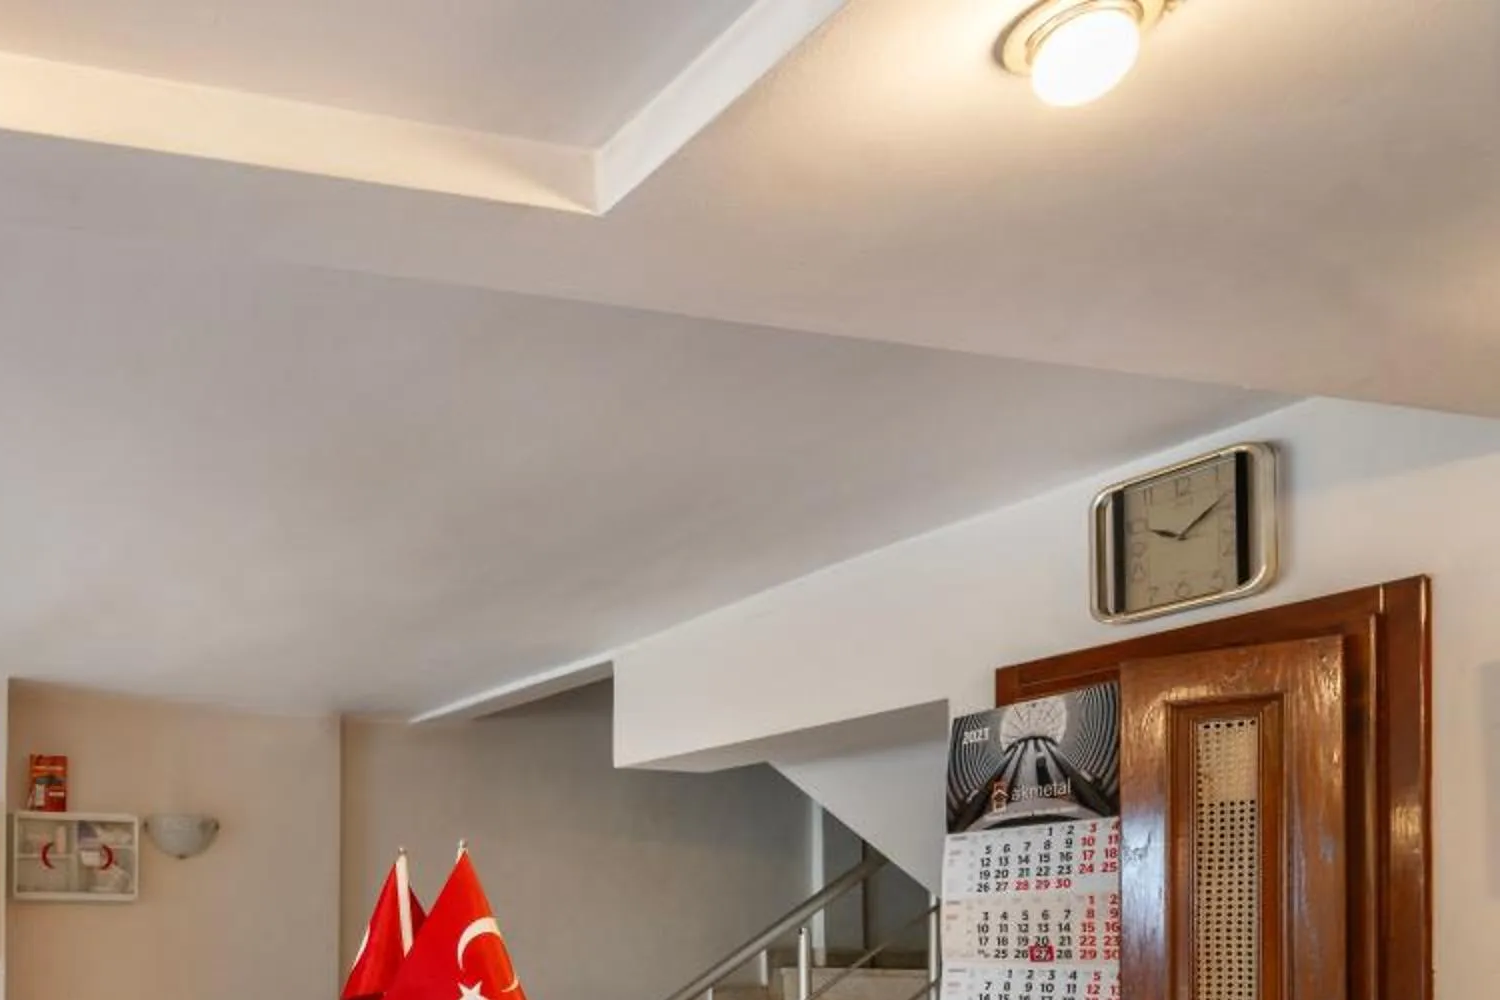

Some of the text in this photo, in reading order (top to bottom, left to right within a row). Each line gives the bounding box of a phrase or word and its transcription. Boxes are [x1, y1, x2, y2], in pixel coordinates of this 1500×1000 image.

[1011, 777, 1071, 801] akmetal
[1048, 828, 1053, 836] 1
[1068, 825, 1074, 834] 2
[1090, 823, 1096, 833] 3
[986, 836, 1119, 854] 5 6 7 8 9 10 11
[980, 849, 1117, 867] 12 13 14 15 16 17 18
[980, 862, 1117, 880] 19 20 21 22 23 24 25
[977, 879, 1071, 892] 26 27 28 29 30
[1089, 894, 1117, 904] 1 2
[983, 909, 1119, 920] 3 4 5 6 7 8 9
[977, 924, 989, 933] 10
[1000, 924, 1008, 932] 11
[1017, 924, 1028, 932] 12
[1037, 923, 1049, 932] 13
[1058, 923, 1071, 932] 14
[1081, 923, 1095, 932] 15
[979, 937, 988, 945] 17
[998, 936, 1008, 945] 18
[1017, 936, 1028, 945] 19
[1035, 936, 1049, 946] 20
[1059, 936, 1071, 945] 21
[1080, 936, 1096, 946] 22
[994, 950, 1008, 958] 25
[1015, 950, 1028, 958] 26
[1036, 950, 1050, 960] 27
[1057, 950, 1072, 959] 28
[1080, 950, 1096, 960] 29
[1008, 970, 1101, 981] 1 2 3 4 5
[985, 982, 991, 990] 7
[1004, 982, 1010, 991] 8
[1025, 982, 1032, 992] 9
[1041, 983, 1055, 992] 10
[1067, 984, 1076, 994] 11
[1087, 984, 1100, 994] 12
